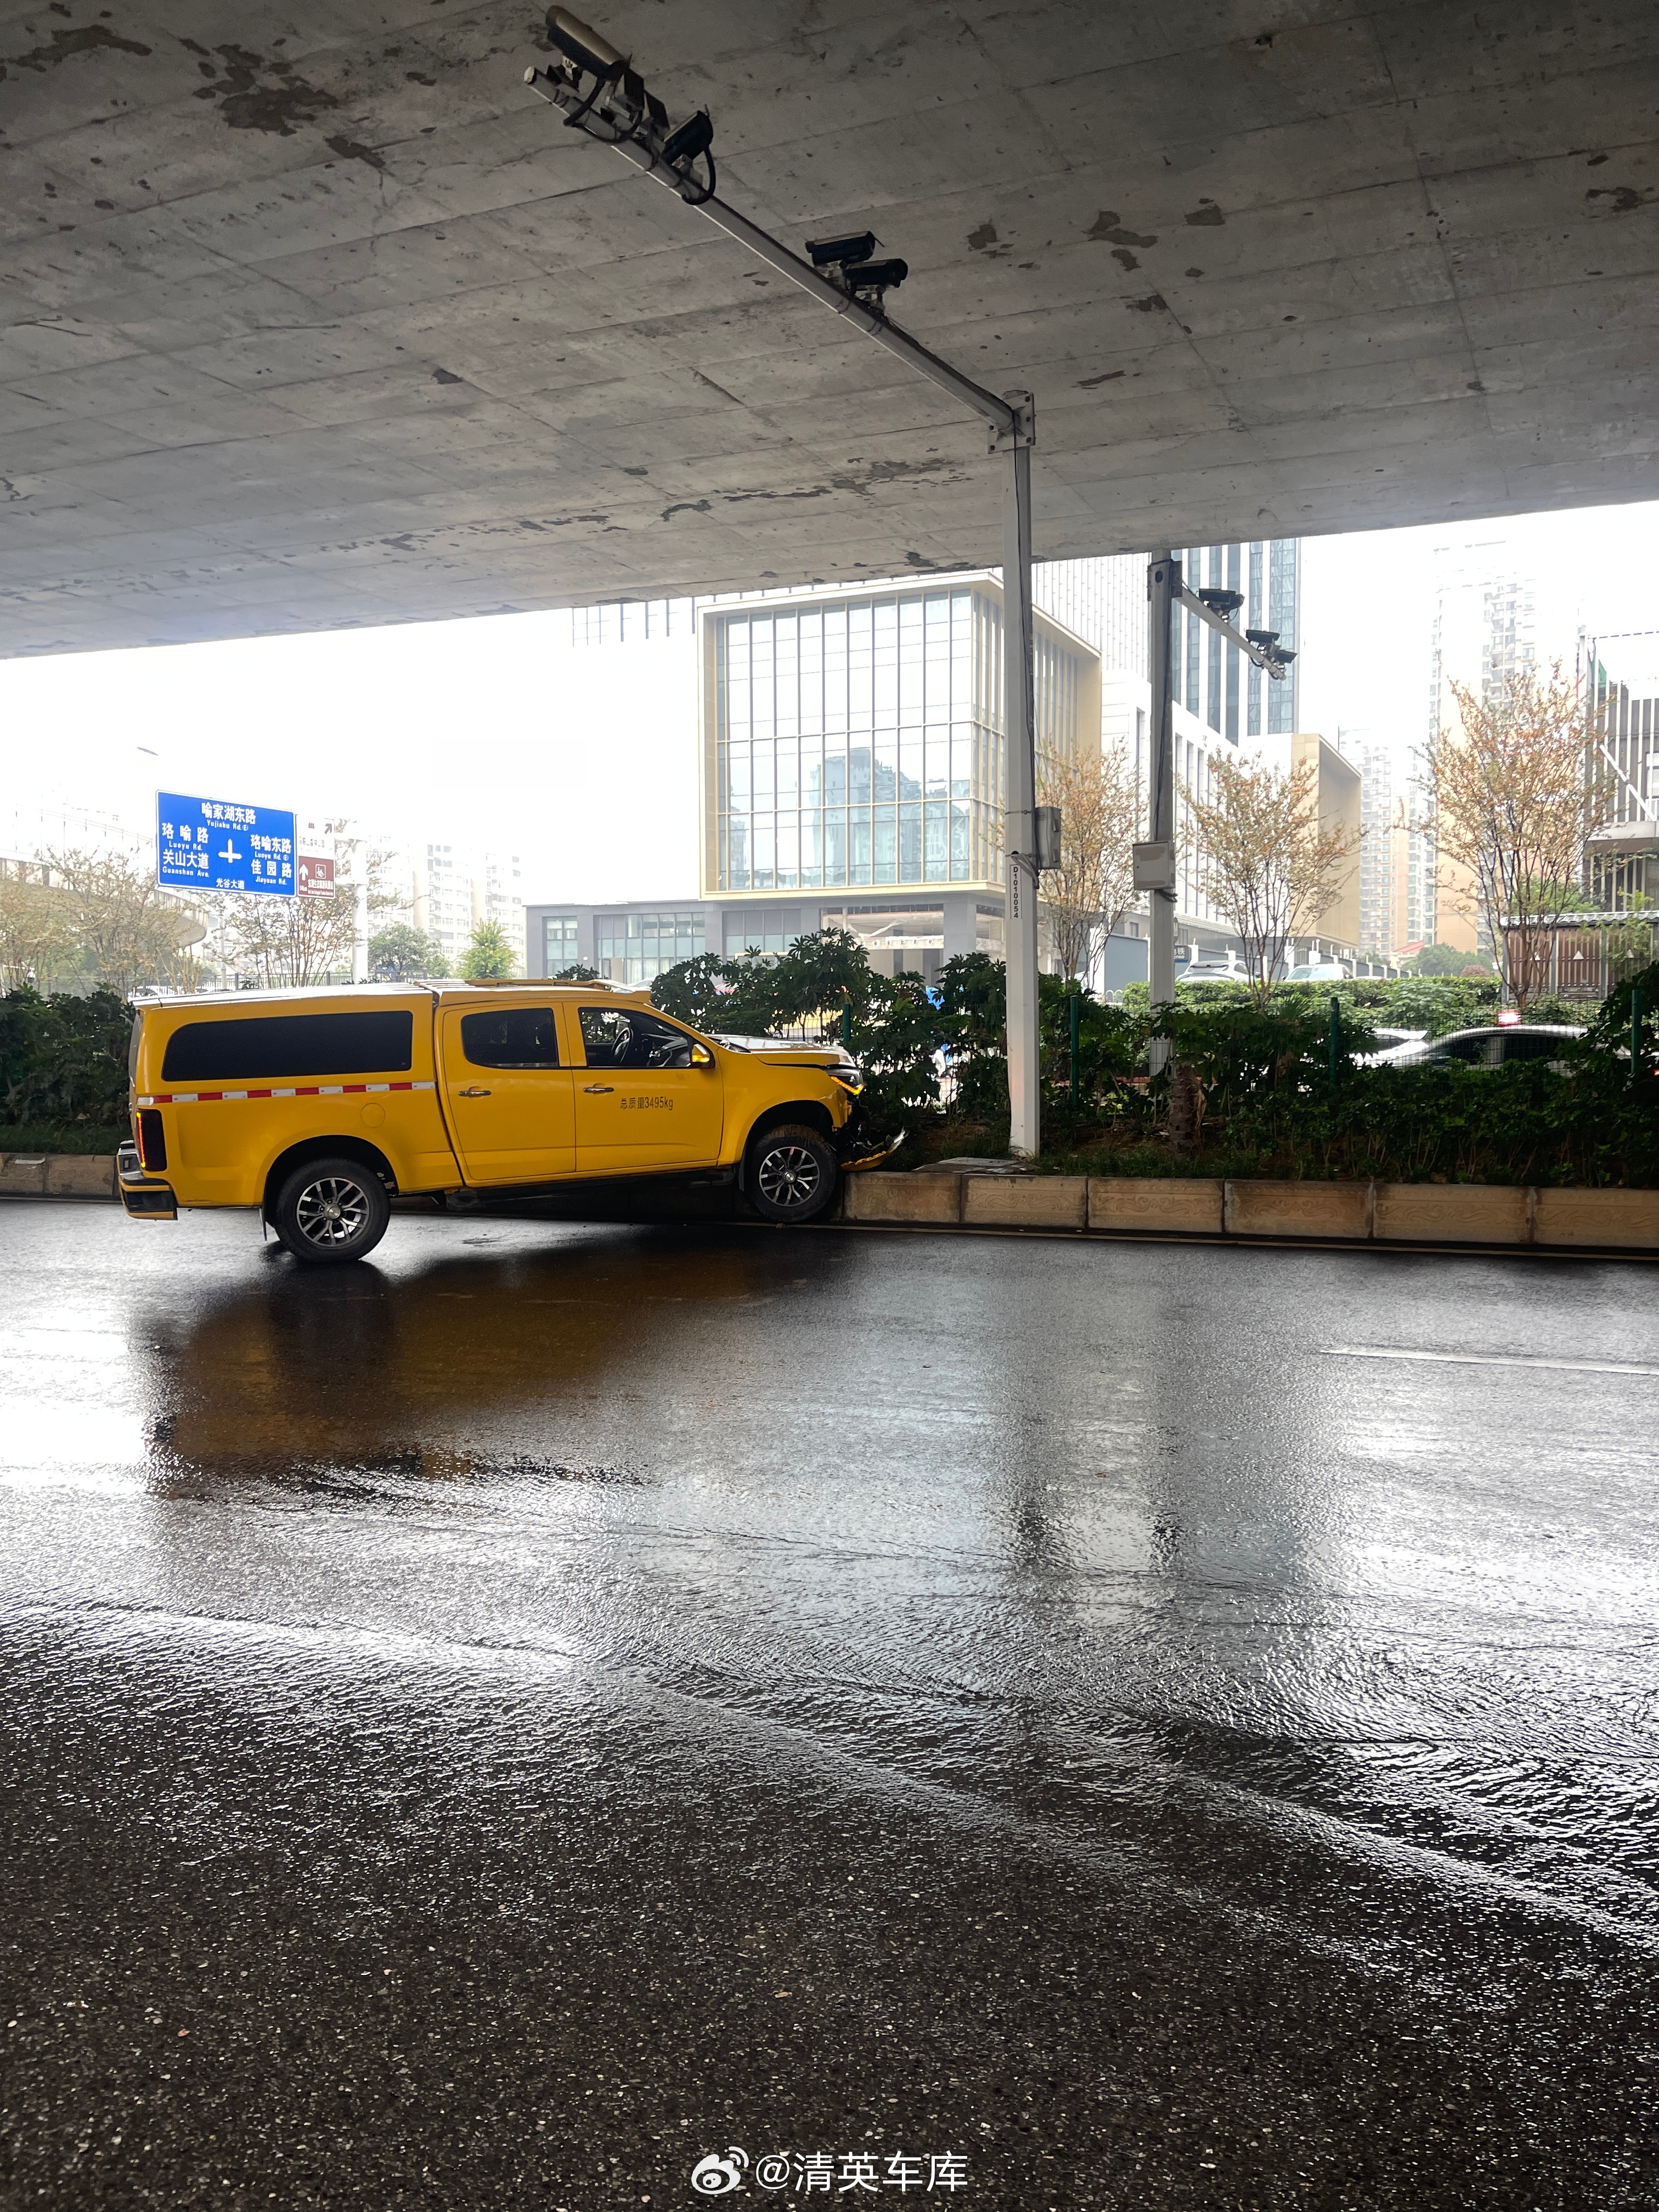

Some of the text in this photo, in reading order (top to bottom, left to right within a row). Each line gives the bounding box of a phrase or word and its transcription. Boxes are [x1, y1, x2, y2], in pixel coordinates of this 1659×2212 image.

[201, 802, 256, 825] 喻家湖东路
[206, 819, 230, 829] Yujiahu
[168, 840, 202, 851] Luoyu Rd.
[250, 834, 292, 854] 珞喻东路
[162, 848, 209, 870] 关山大道
[255, 851, 271, 860] Luoyu
[162, 866, 210, 878] Guanshan Ave.
[216, 878, 245, 890] 光谷大道
[255, 876, 276, 885] Jiayuan
